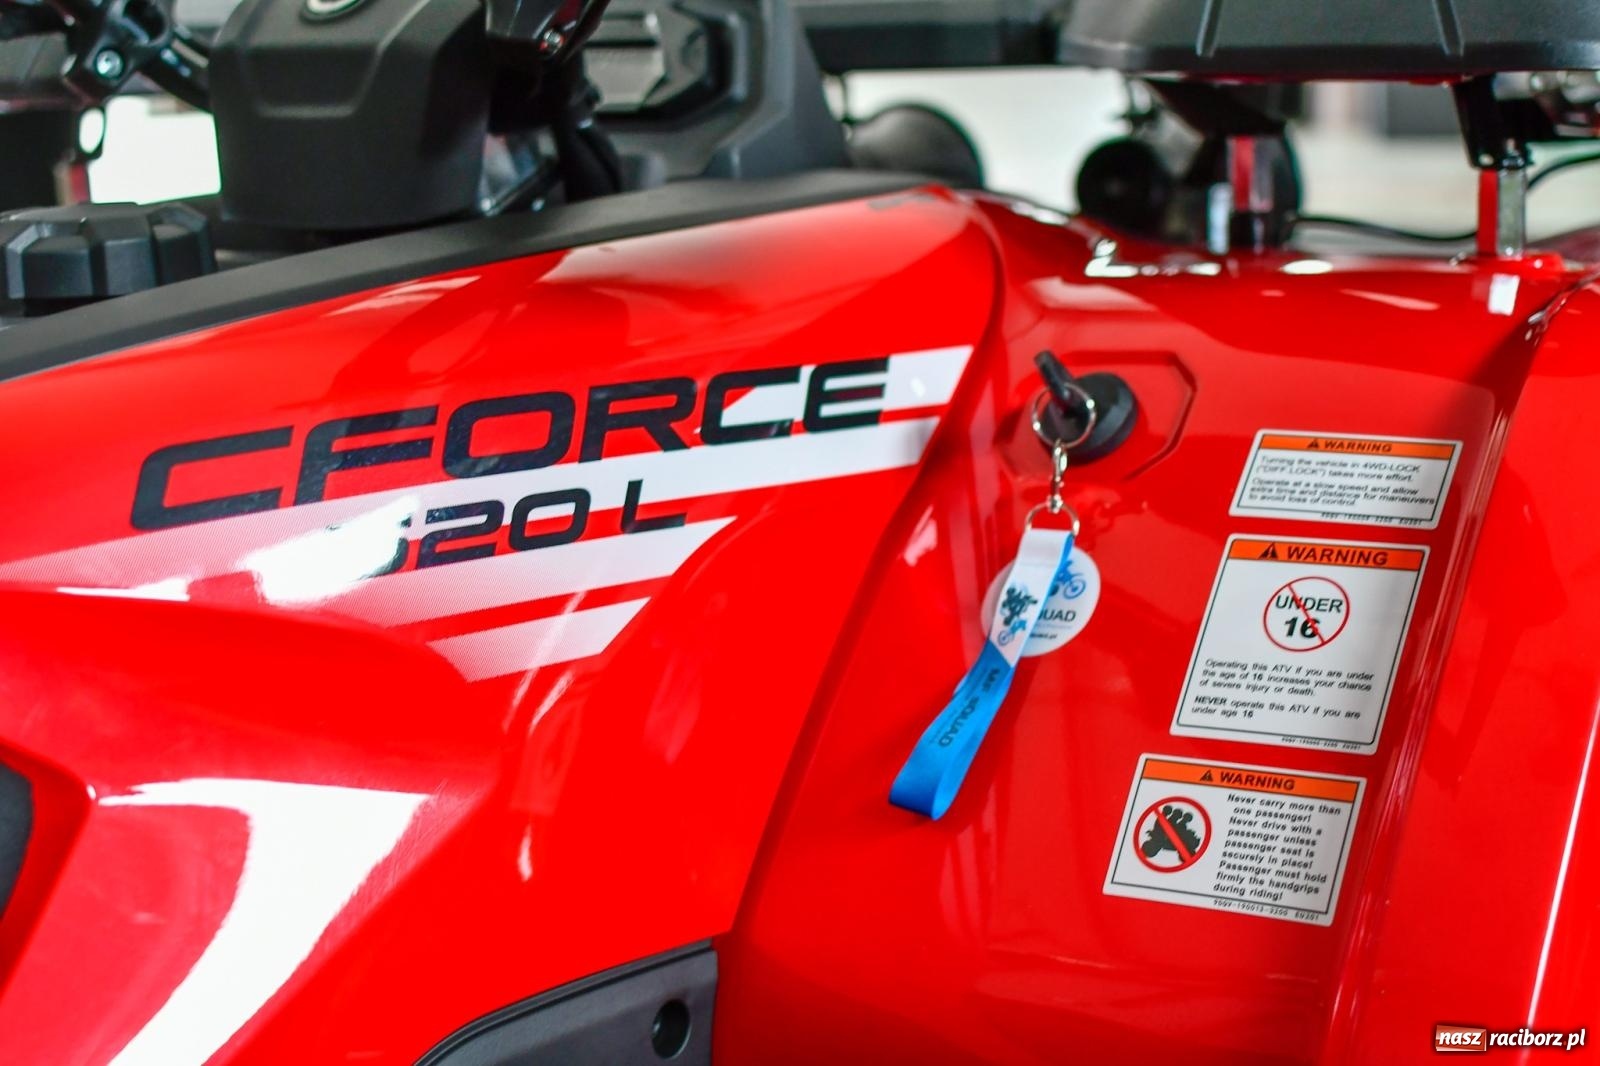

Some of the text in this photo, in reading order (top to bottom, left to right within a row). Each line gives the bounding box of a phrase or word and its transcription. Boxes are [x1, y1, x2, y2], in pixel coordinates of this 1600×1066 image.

[131, 357, 889, 531] CFORCE
[1324, 440, 1392, 453] WARNING
[1262, 456, 1294, 466] Turning
[1252, 478, 1290, 486] Operate
[1338, 483, 1368, 492] speed
[1320, 490, 1360, 498] distance
[1378, 495, 1435, 504] maneuvers
[350, 479, 688, 578] 20 L
[1287, 546, 1389, 566] WARNING
[1274, 594, 1344, 613] UNDER
[1284, 617, 1320, 638] 16
[1206, 658, 1248, 670] Operating
[1252, 663, 1268, 671] this
[1272, 664, 1292, 673] ATV
[1295, 666, 1302, 674] if
[1306, 669, 1323, 677] you
[1346, 672, 1374, 680] under
[1245, 683, 1270, 693] injury
[1252, 673, 1264, 681] 16
[1267, 675, 1310, 685] increases
[1314, 680, 1336, 688] your
[1338, 681, 1372, 691] chance
[1192, 706, 1254, 718] under age 16
[1194, 696, 1361, 719] NEVER operate this ATV if you are
[1220, 771, 1296, 790] WARNING
[1226, 794, 1342, 815] Never carry more than
[1234, 806, 1312, 822] one passenger!
[1228, 816, 1258, 828] Never
[1262, 820, 1287, 832] drive
[1291, 824, 1312, 834] with
[1228, 829, 1317, 846] passenger unless
[1224, 839, 1315, 858] passenger seat is
[1222, 850, 1313, 870] securely in place!
[1219, 860, 1328, 884] Passenger must hold
[1216, 872, 1320, 894] firmly the handgrips
[1214, 884, 1284, 902] during riding!
